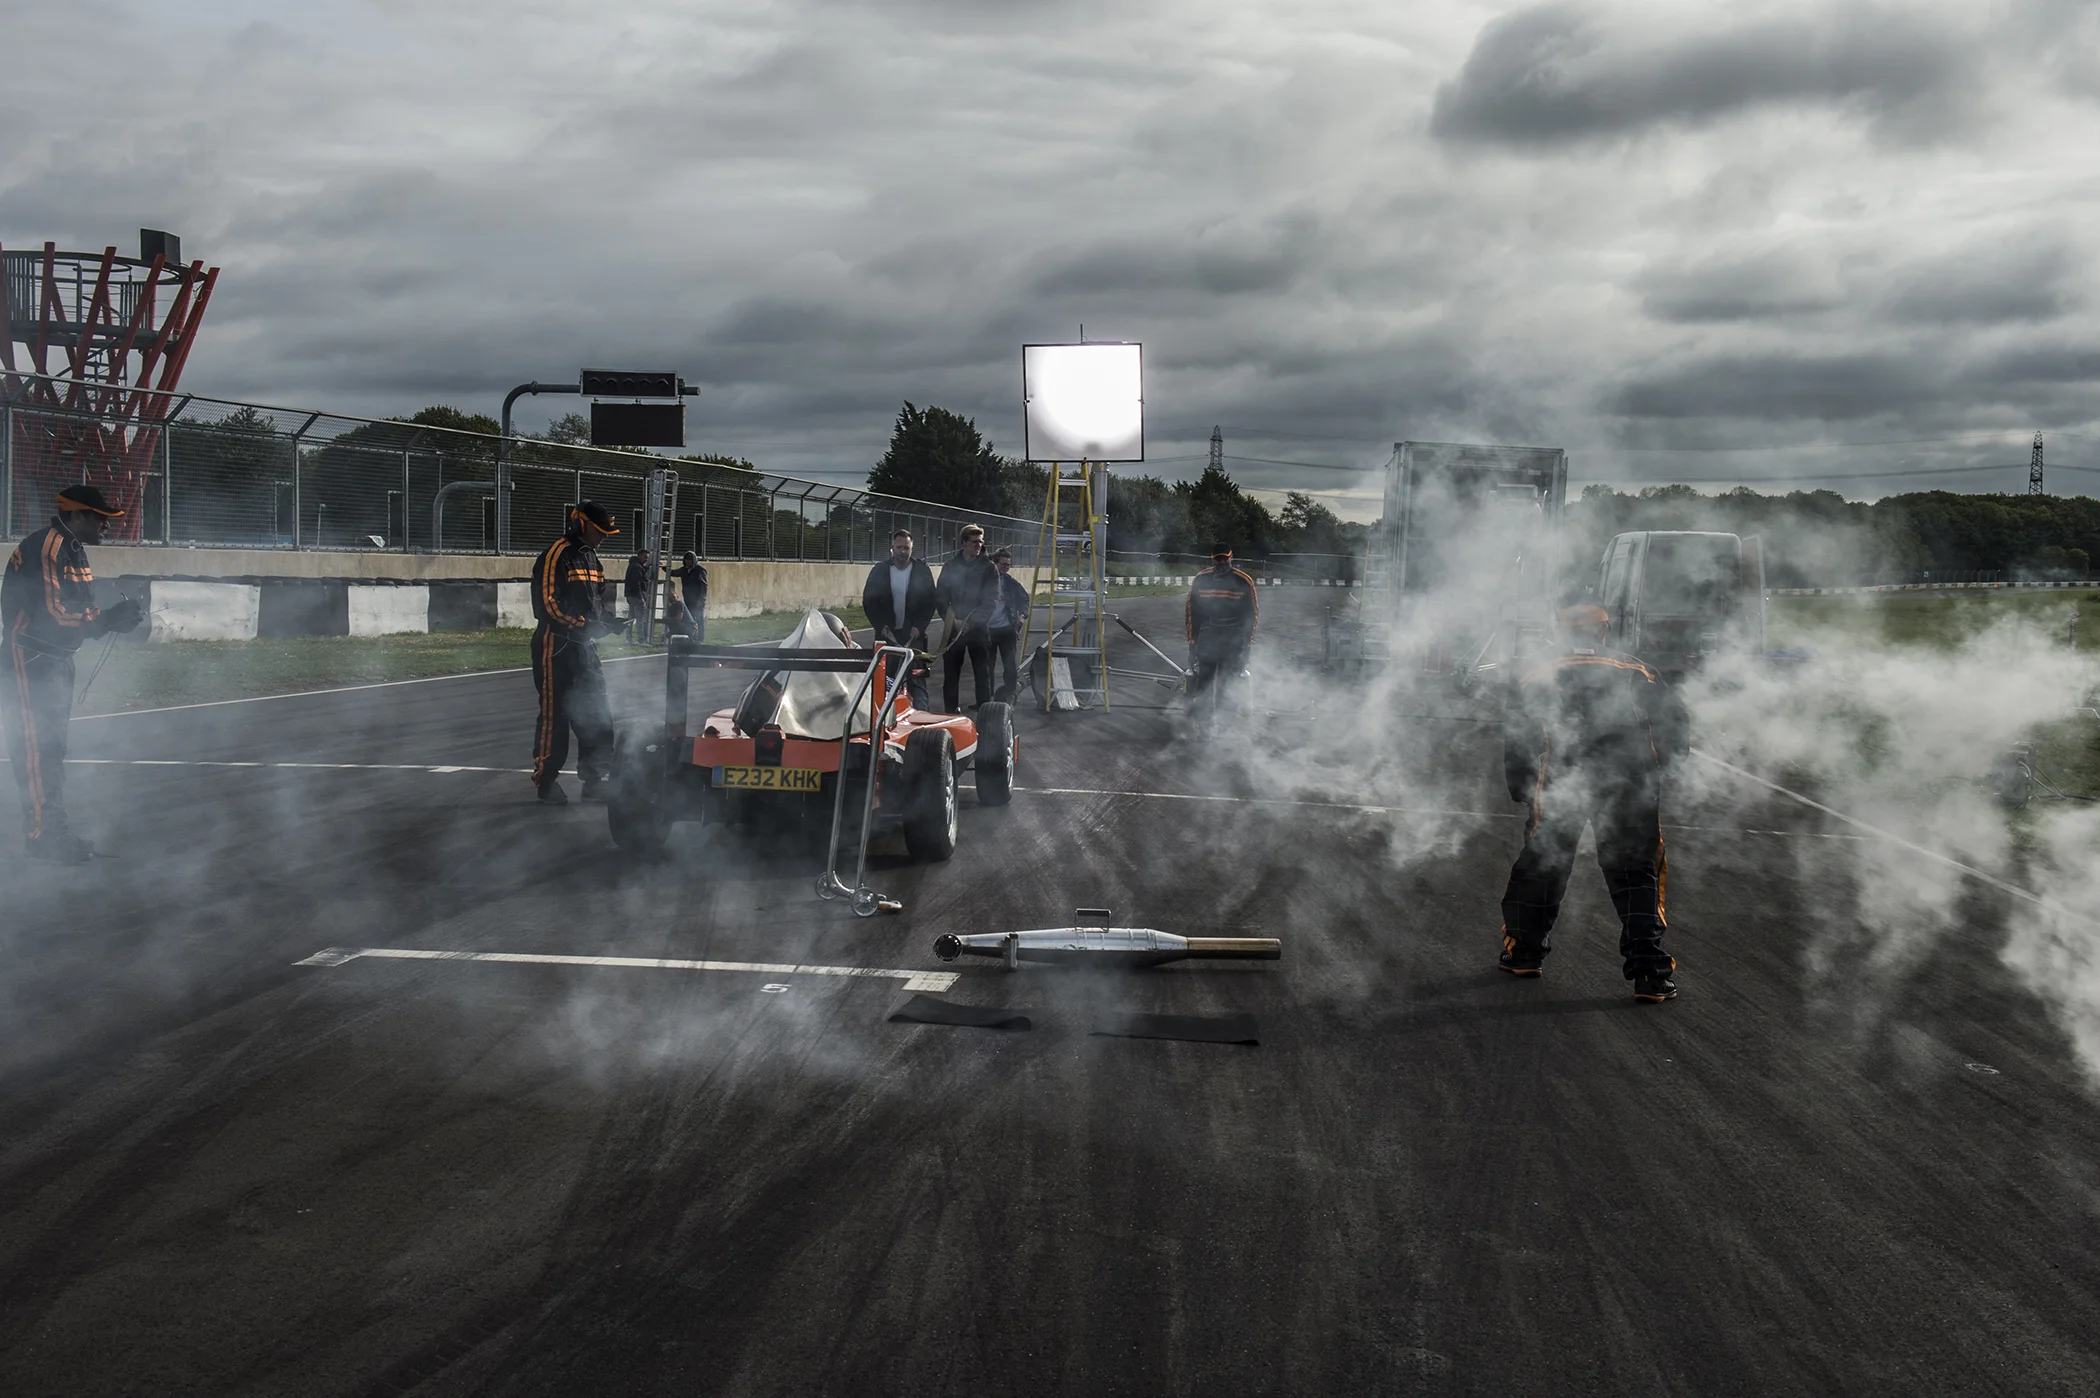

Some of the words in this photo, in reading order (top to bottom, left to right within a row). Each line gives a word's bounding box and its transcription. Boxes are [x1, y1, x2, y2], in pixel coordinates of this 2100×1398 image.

[723, 767, 775, 787] E232
[780, 769, 819, 789] KHK
[760, 983, 792, 993] 5
